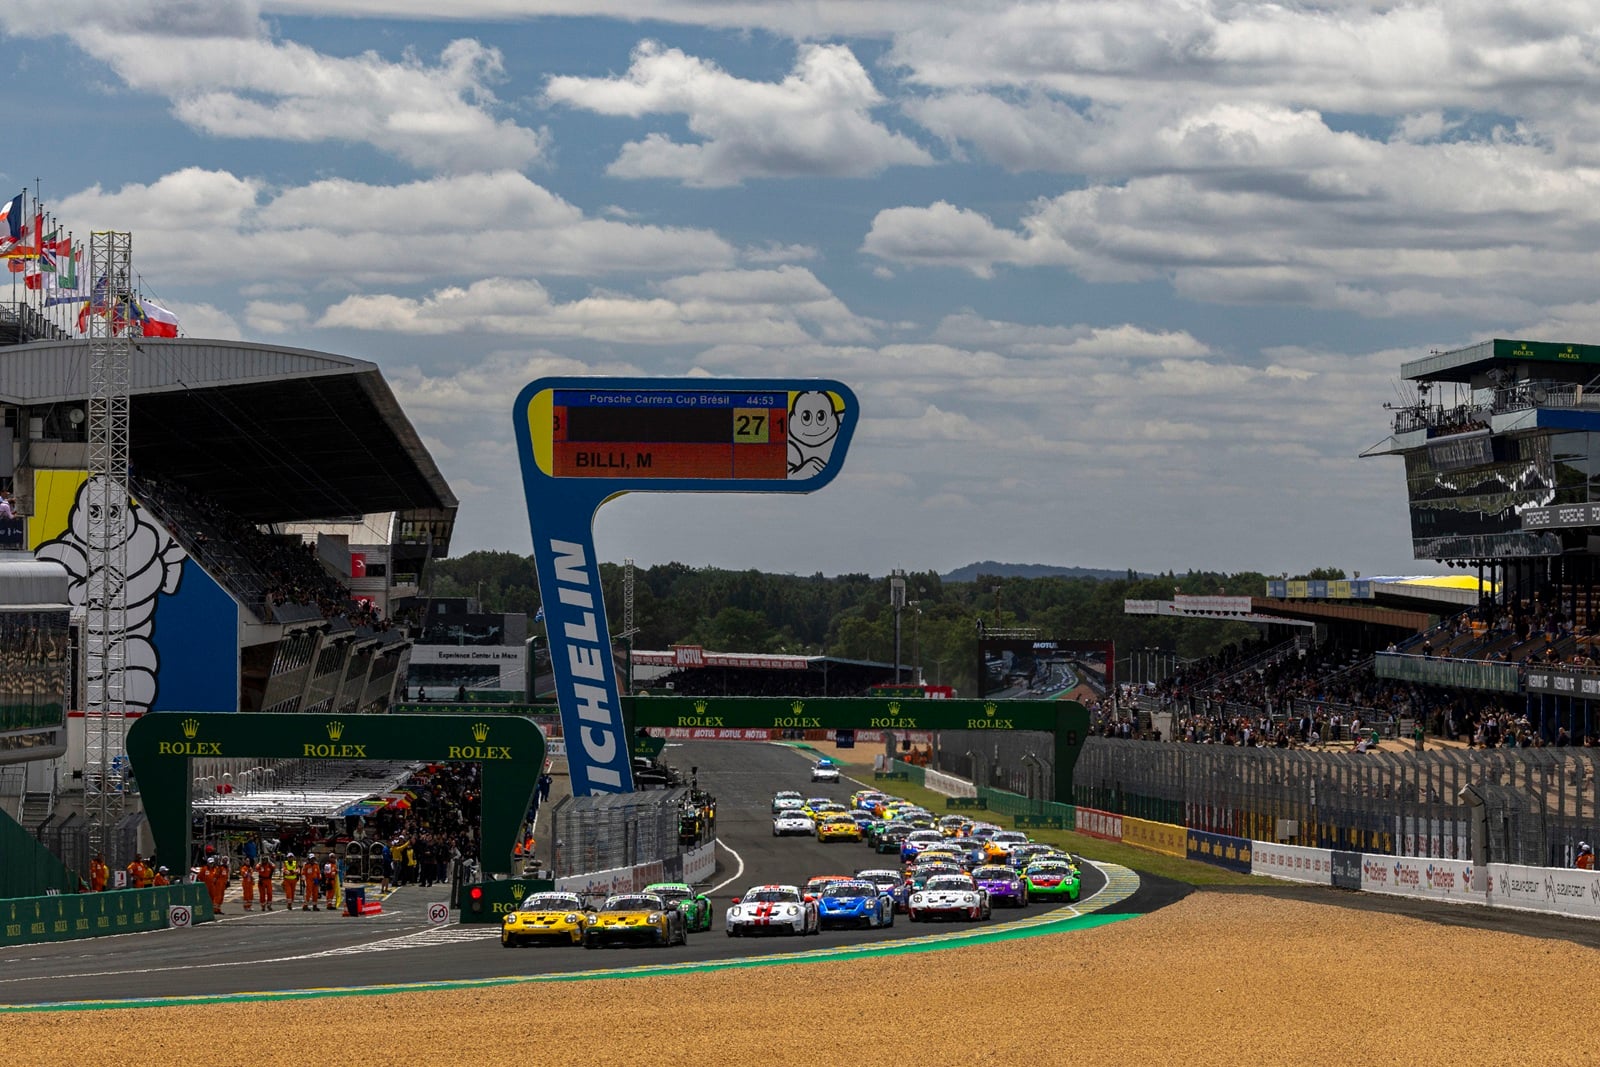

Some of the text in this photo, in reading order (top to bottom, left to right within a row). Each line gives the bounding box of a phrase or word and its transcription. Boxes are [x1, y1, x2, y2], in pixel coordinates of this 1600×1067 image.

[589, 394, 729, 406] Porsche Carrera Cup Brésil
[746, 396, 774, 405] 44:53
[737, 416, 765, 436] 27
[576, 452, 652, 470] BILLI, M
[438, 651, 470, 659] Experience
[677, 648, 703, 664] MOTUL
[550, 538, 622, 798] ICHELIN
[678, 716, 724, 727] ROLEX
[774, 717, 821, 727] ROLEX
[871, 717, 917, 728] ROLEX
[968, 719, 1014, 729] ROLEX
[694, 729, 716, 738] MOTUL
[719, 730, 741, 738] MOTUL
[744, 730, 768, 739] MOTUL
[159, 742, 222, 755] ROLEX
[303, 744, 367, 757] ROLEX
[448, 746, 512, 759] ROLEX
[173, 911, 187, 921] 60
[432, 909, 445, 918] 60
